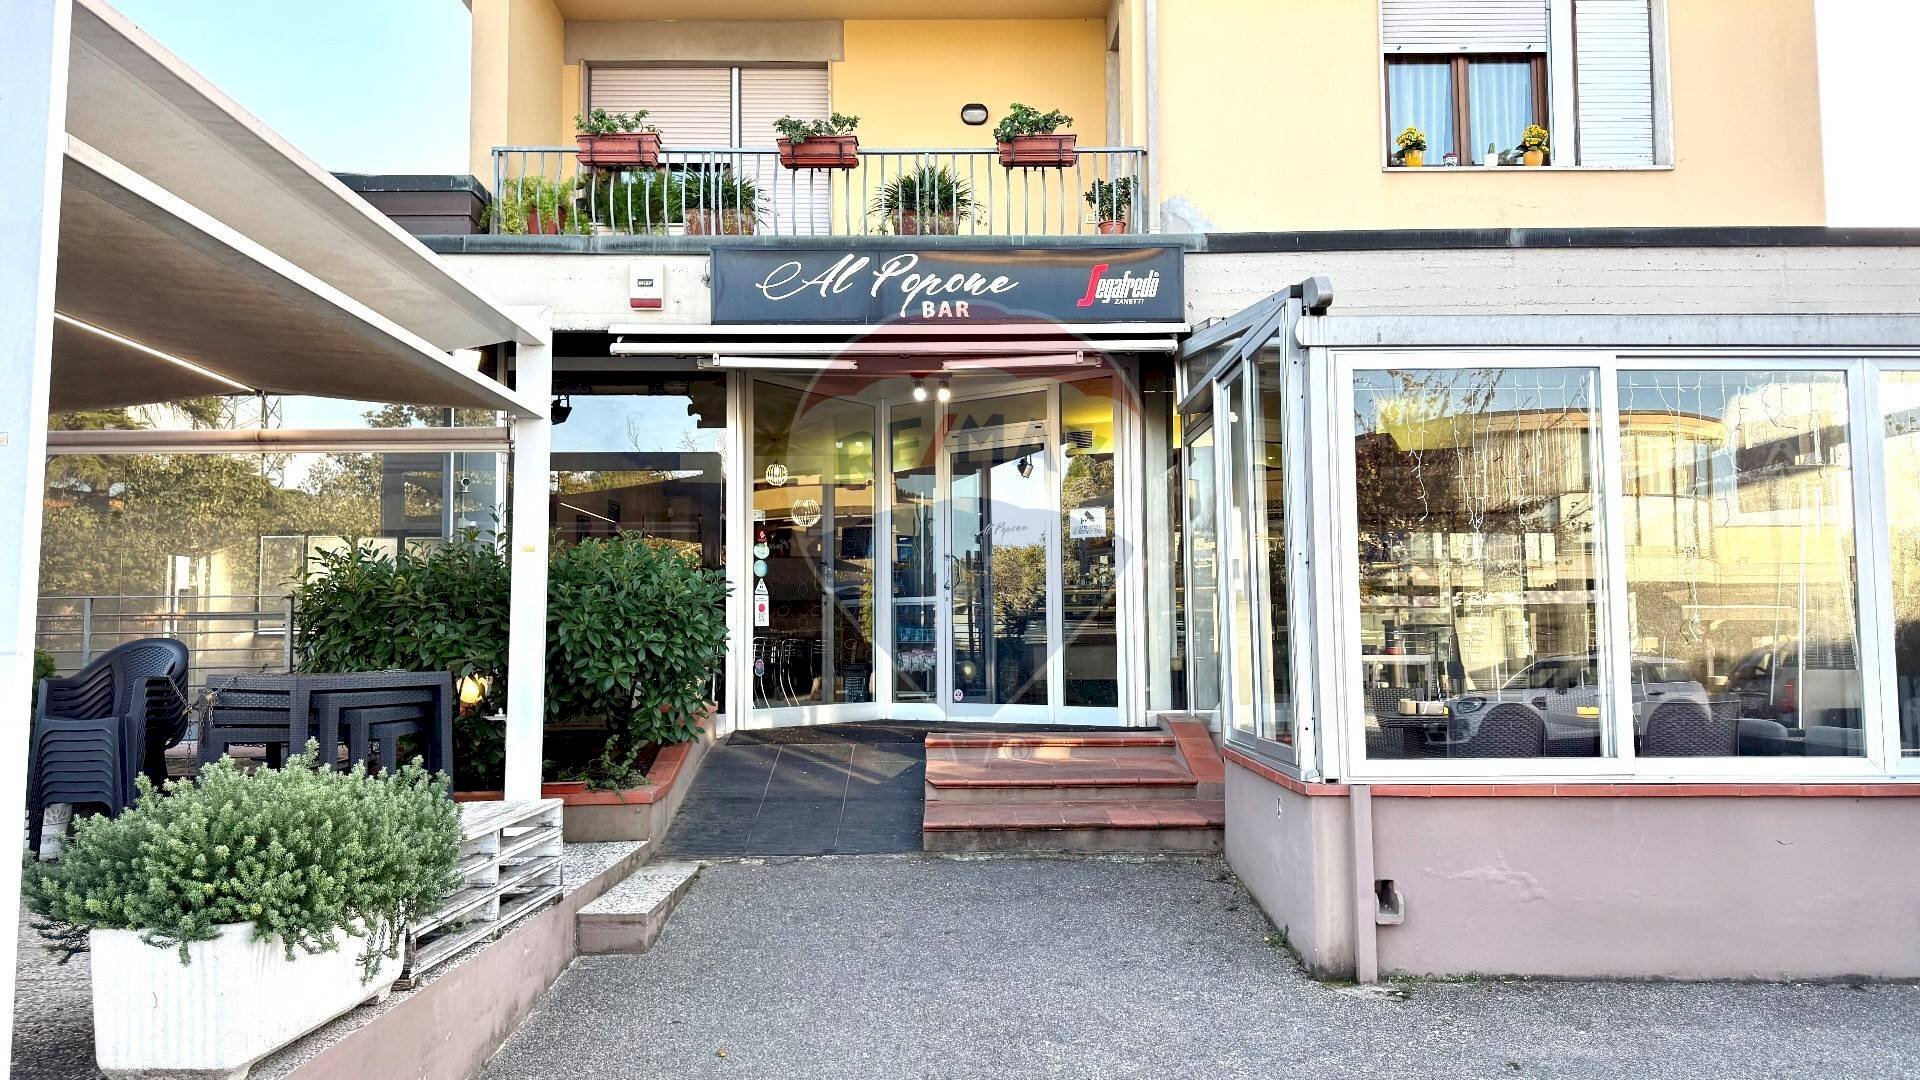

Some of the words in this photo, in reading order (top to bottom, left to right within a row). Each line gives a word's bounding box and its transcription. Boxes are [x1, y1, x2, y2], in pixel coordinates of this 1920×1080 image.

[755, 253, 870, 300] Al
[870, 253, 1020, 318] Popone
[1077, 264, 1160, 307] Segafredo
[922, 301, 970, 318] BAR
